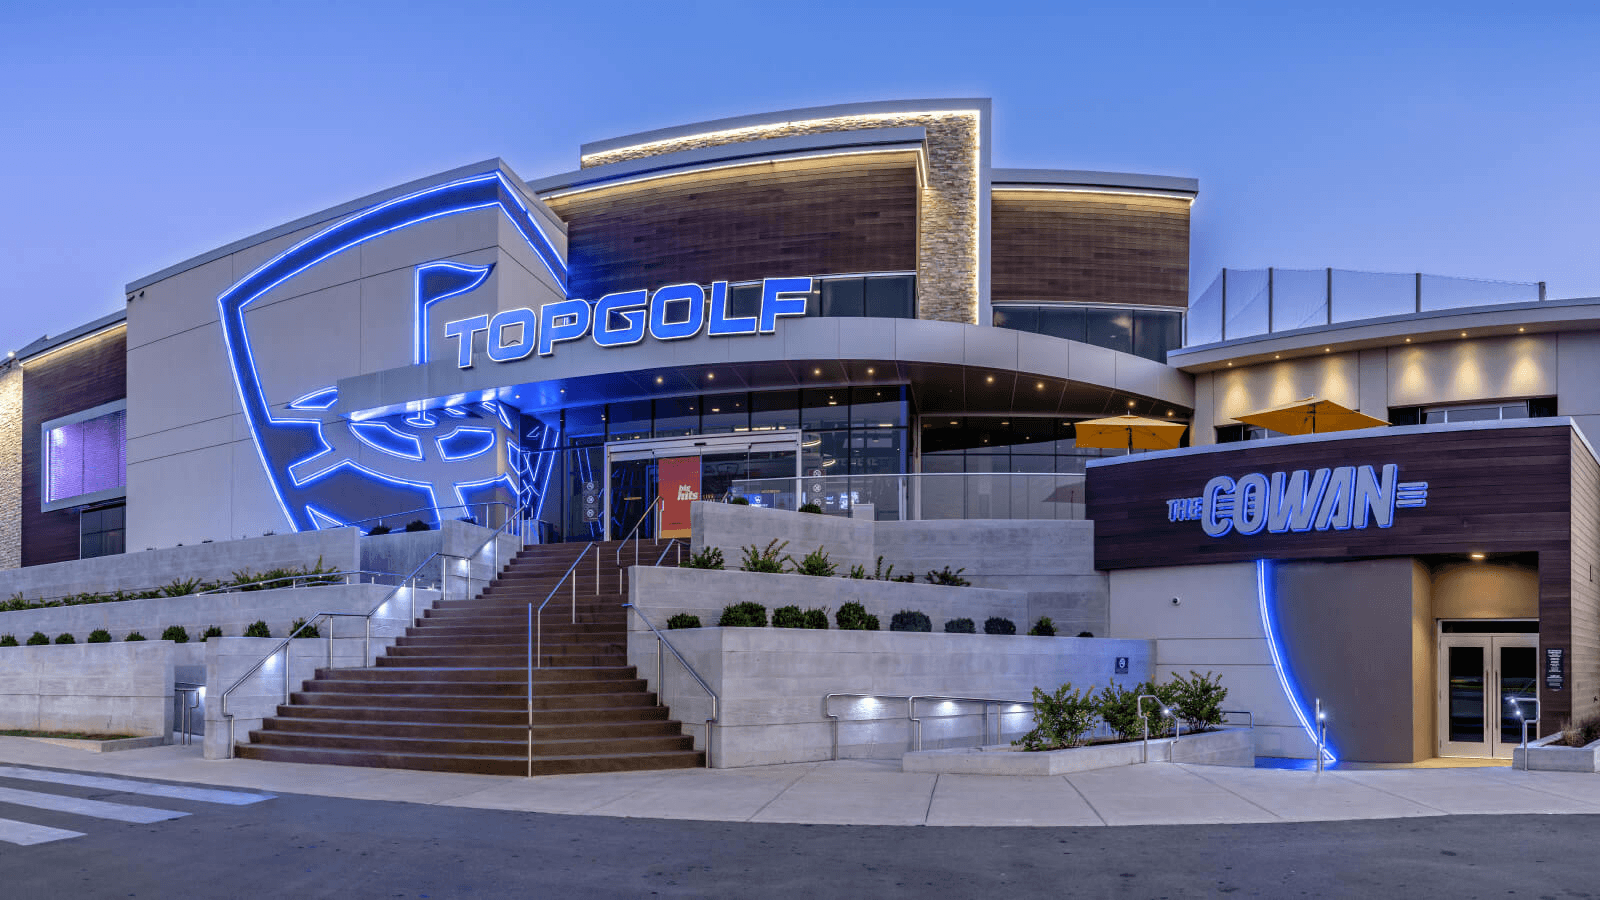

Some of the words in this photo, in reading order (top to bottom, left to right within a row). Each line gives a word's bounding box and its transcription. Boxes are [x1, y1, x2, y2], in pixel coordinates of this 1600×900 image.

[445, 277, 813, 369] TOPGOLF
[677, 490, 699, 501] hits
[1166, 497, 1203, 522] THE
[1201, 463, 1398, 537] COWAN
